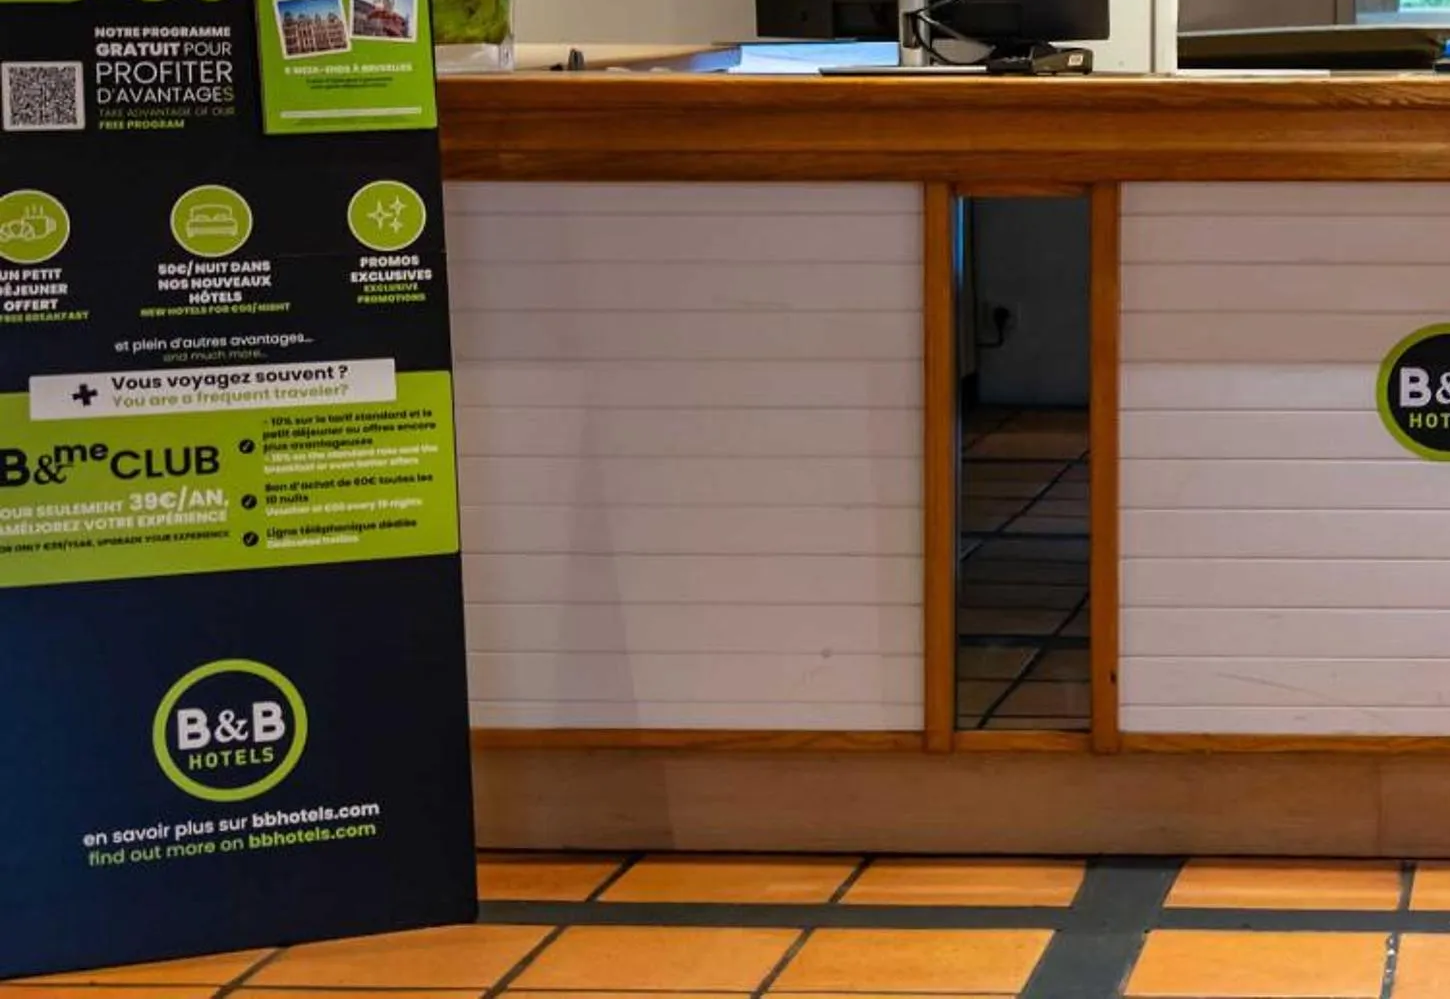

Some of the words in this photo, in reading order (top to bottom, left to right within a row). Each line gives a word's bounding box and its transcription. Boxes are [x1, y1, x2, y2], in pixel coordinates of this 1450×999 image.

[94, 26, 141, 38] NOTRE
[142, 26, 231, 38] PROGRAMME
[95, 42, 181, 57] GRATUIT
[183, 41, 233, 56] POUR
[96, 61, 233, 84] PROFITER
[97, 86, 234, 104] D'AVANTAGES
[100, 107, 123, 117] TAKE
[127, 107, 191, 117] ADVANTAGE
[212, 106, 236, 116] OUR
[99, 120, 124, 130] FREE
[127, 119, 185, 130] PROGRAM
[230, 260, 271, 273] DANS
[360, 255, 420, 268] PROMOS
[0, 269, 20, 281] UN
[22, 268, 63, 281] PETIT
[350, 269, 433, 283] EXCLUSIVES
[158, 278, 189, 291] NOS
[191, 275, 272, 289] NOUVEAUX
[363, 282, 419, 292] EXCLUSIVE
[188, 290, 243, 304] HÔTELS
[357, 293, 426, 304] PROMOTIONS
[3, 299, 59, 312] OFFERT
[140, 307, 165, 317] NEW
[167, 306, 207, 316] HOTELS
[25, 311, 90, 322] BREAKFAST
[115, 340, 130, 352] et
[132, 338, 167, 353] plein
[170, 335, 227, 349] d'autres
[163, 351, 188, 362] and
[191, 348, 227, 360] much
[112, 375, 162, 390] Vous
[167, 372, 251, 389] voyagez
[256, 366, 334, 383] souvent
[338, 364, 349, 379] ?
[113, 394, 145, 408] You
[149, 393, 178, 406] are
[181, 393, 193, 404] a
[197, 387, 270, 404] frequent
[273, 383, 349, 399] traveler?
[295, 417, 313, 425] sur
[328, 412, 353, 422] tarif
[355, 410, 407, 421] standard
[263, 429, 290, 441] petit
[292, 426, 342, 439] déjeuner
[363, 423, 395, 432] offres
[398, 422, 437, 431] encore
[263, 442, 288, 455] plus
[291, 437, 373, 450] avantageuses
[110, 446, 220, 480] CLUB
[265, 483, 287, 492] Bon
[290, 479, 335, 491] d'achat
[337, 478, 352, 488] de
[379, 475, 415, 485] toutes
[417, 473, 433, 482] les
[280, 493, 309, 503] nuits
[36, 501, 123, 518] SEULEMENT
[83, 516, 135, 531] VOTRE
[137, 508, 228, 528] EXPÉRIENCE
[266, 526, 298, 541] Ligne
[300, 521, 377, 535] téléphonique
[378, 518, 417, 529] dédiée
[97, 535, 142, 546] UPGRADE
[144, 534, 171, 543] YOUR
[173, 530, 229, 541] EXPERIENCE
[177, 701, 286, 750] B&B
[188, 746, 275, 770] HOTELS
[83, 831, 107, 848] en
[113, 823, 170, 845] savoir
[175, 820, 214, 842] plus
[219, 818, 248, 832] sur
[252, 802, 381, 829] bbhotels.com
[89, 848, 125, 867] find
[130, 846, 162, 862] out
[166, 841, 215, 859] more
[220, 838, 245, 852] on
[248, 822, 376, 848] bbhotels.com
